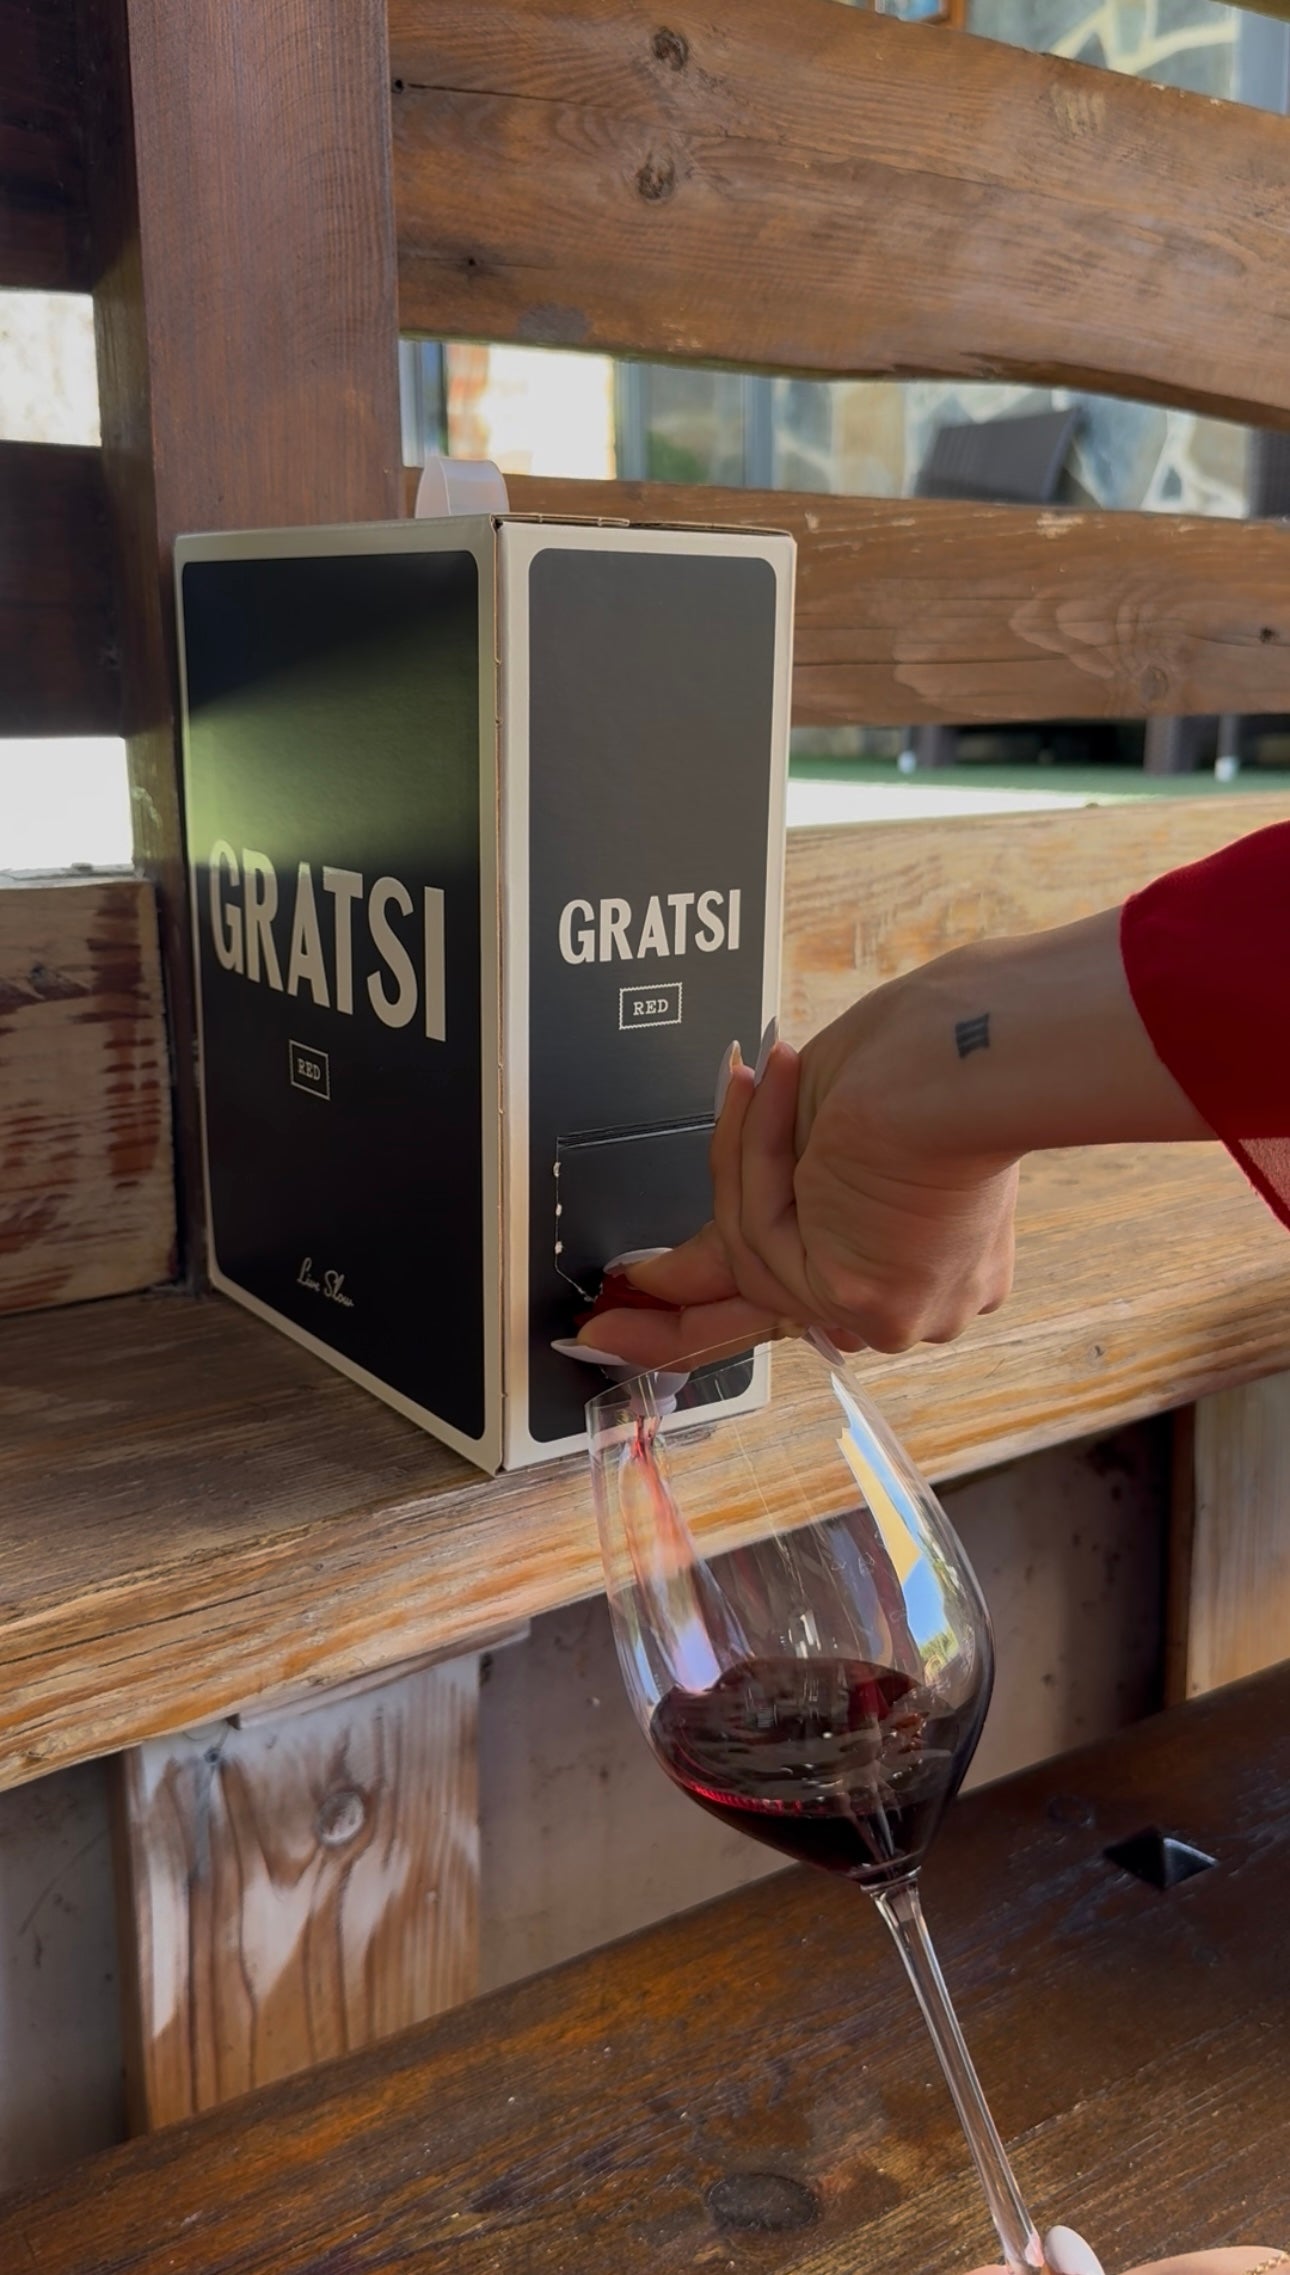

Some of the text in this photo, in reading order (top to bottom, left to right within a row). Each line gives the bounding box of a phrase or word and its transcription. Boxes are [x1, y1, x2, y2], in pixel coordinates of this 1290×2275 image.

[209, 839, 446, 1042] GRATSI
[558, 888, 741, 965] GRATSI
[633, 999, 669, 1016] RED
[297, 1058, 321, 1081] RED
